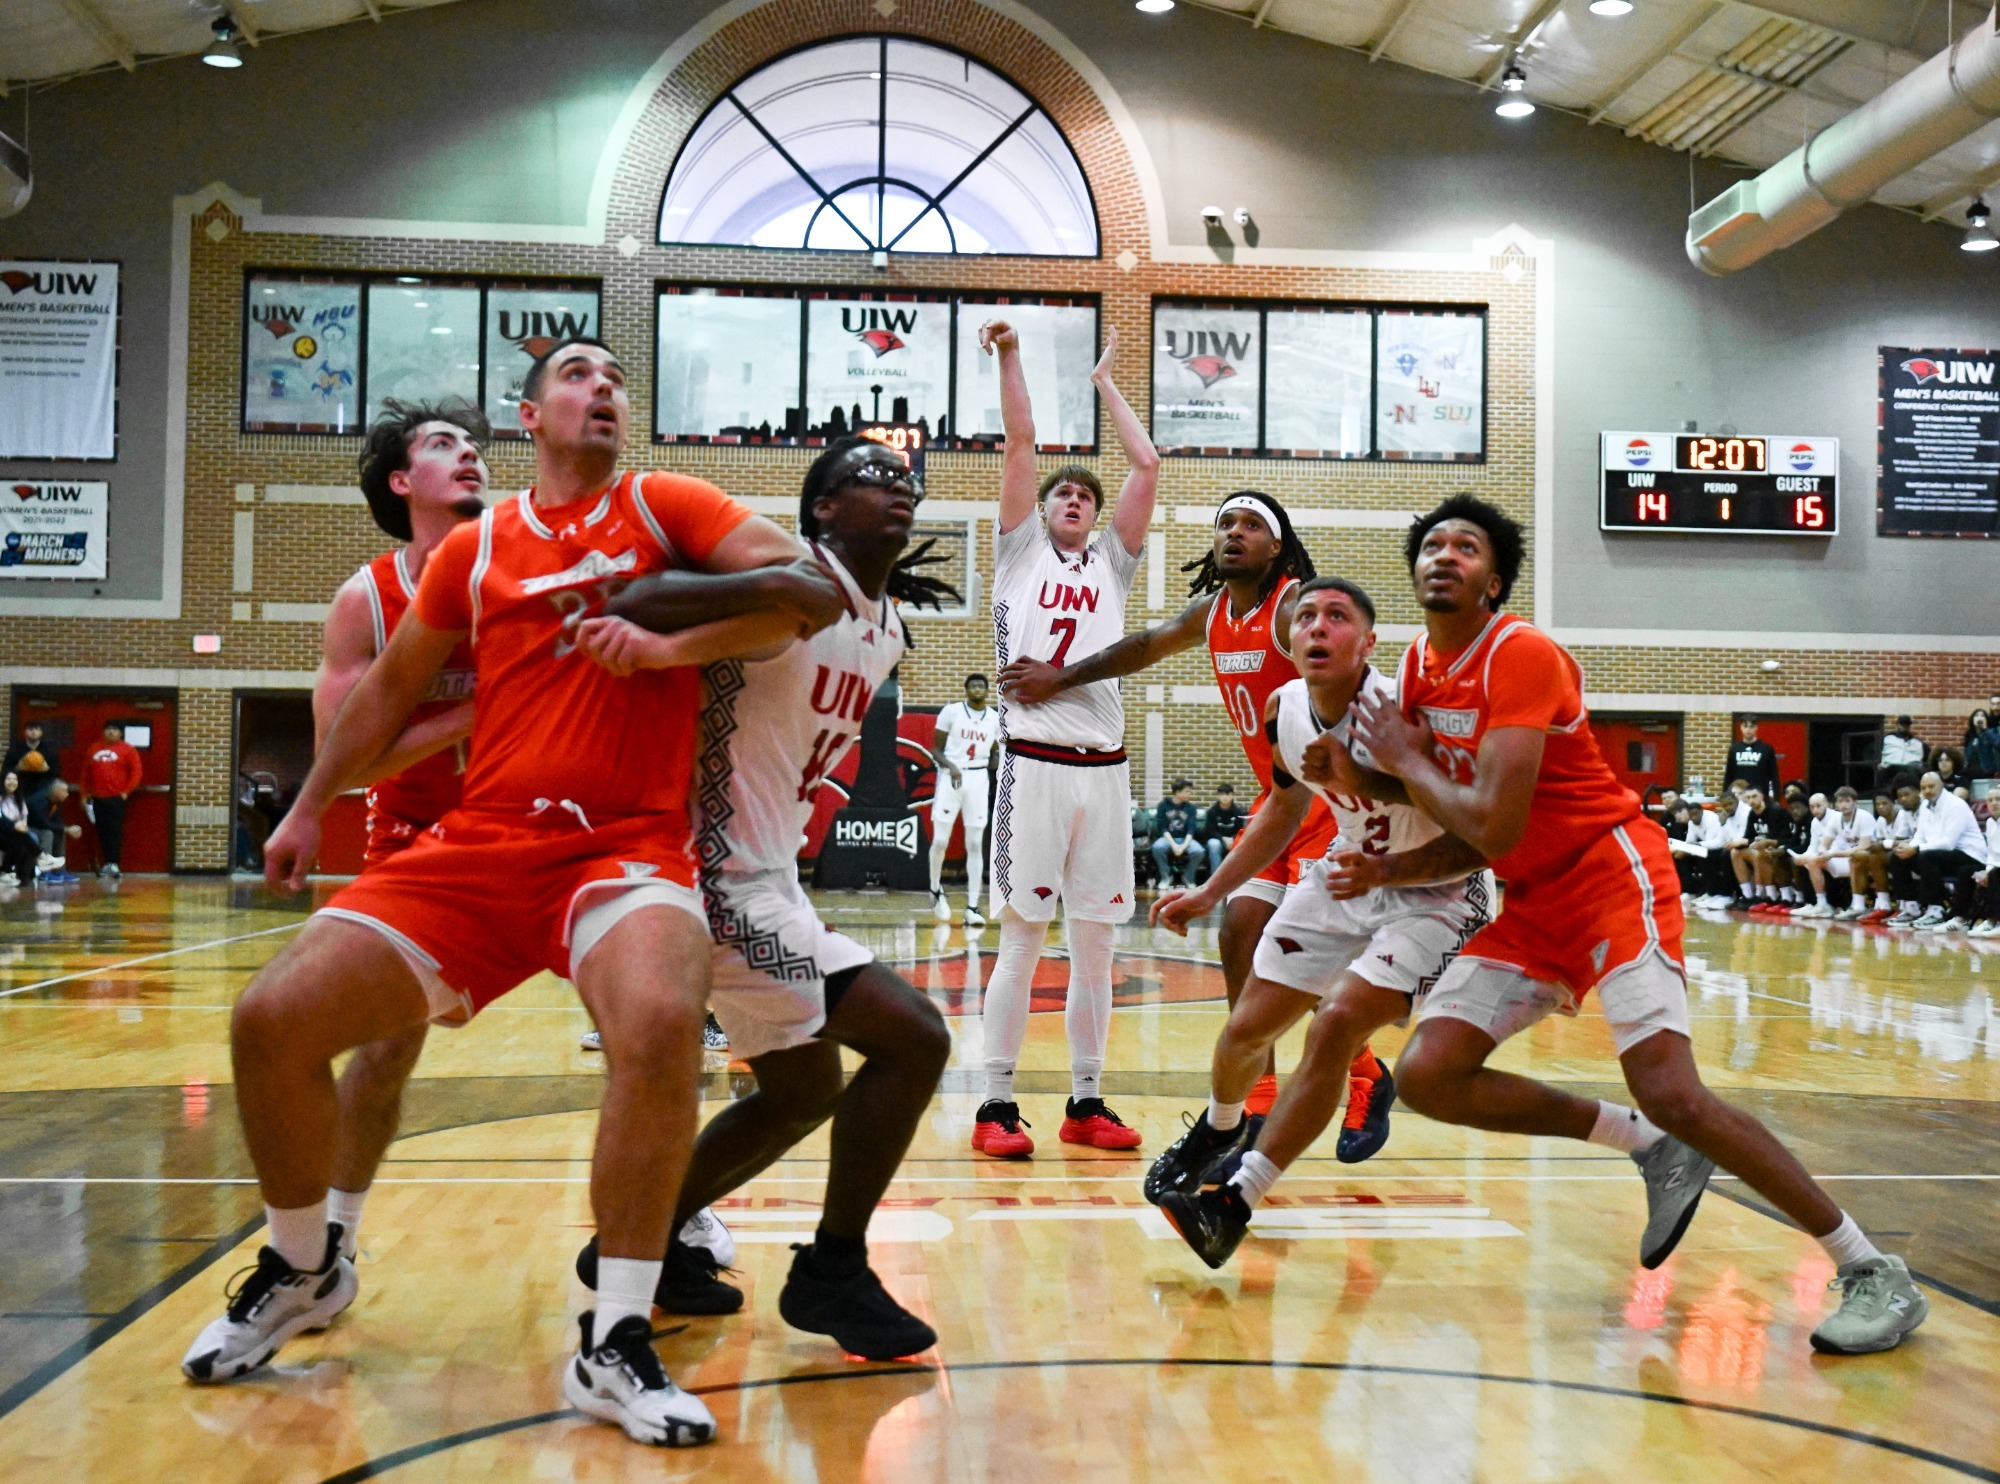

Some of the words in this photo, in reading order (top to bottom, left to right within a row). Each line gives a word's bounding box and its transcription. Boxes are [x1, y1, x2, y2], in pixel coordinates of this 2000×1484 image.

[34, 271, 98, 296] UIW
[40, 303, 110, 314] BASKETBALL
[253, 304, 305, 323] UIW
[499, 310, 589, 340] UIW
[841, 307, 918, 334] UIW
[1165, 329, 1251, 361] UIW
[847, 367, 908, 377] VOLLEYBALL
[1936, 360, 1996, 385] UIW
[1893, 388, 1931, 400] MEN'S
[1932, 389, 2000, 402] BASKETBALL
[1187, 399, 1225, 408] MEN'S
[1171, 410, 1240, 421] BASKETBALL
[1626, 449, 1652, 457] PEPSI
[1690, 438, 1764, 470] 12:07
[1628, 473, 1656, 488] UIW
[1704, 482, 1738, 494] PERIOD
[1776, 476, 1820, 492] GUEST
[37, 486, 82, 502] UIW
[40, 506, 94, 515] BASKETBALL
[1638, 493, 1666, 521] 14
[1721, 498, 1730, 520] 1
[1796, 496, 1823, 527] 15
[20, 533, 65, 548] MARCH
[25, 547, 85, 563] MADNESS
[1047, 618, 1077, 669] 7
[1216, 652, 1262, 671] UTRGV
[961, 729, 988, 742] UIW
[966, 743, 976, 761] 4
[1735, 751, 1762, 762] UIW
